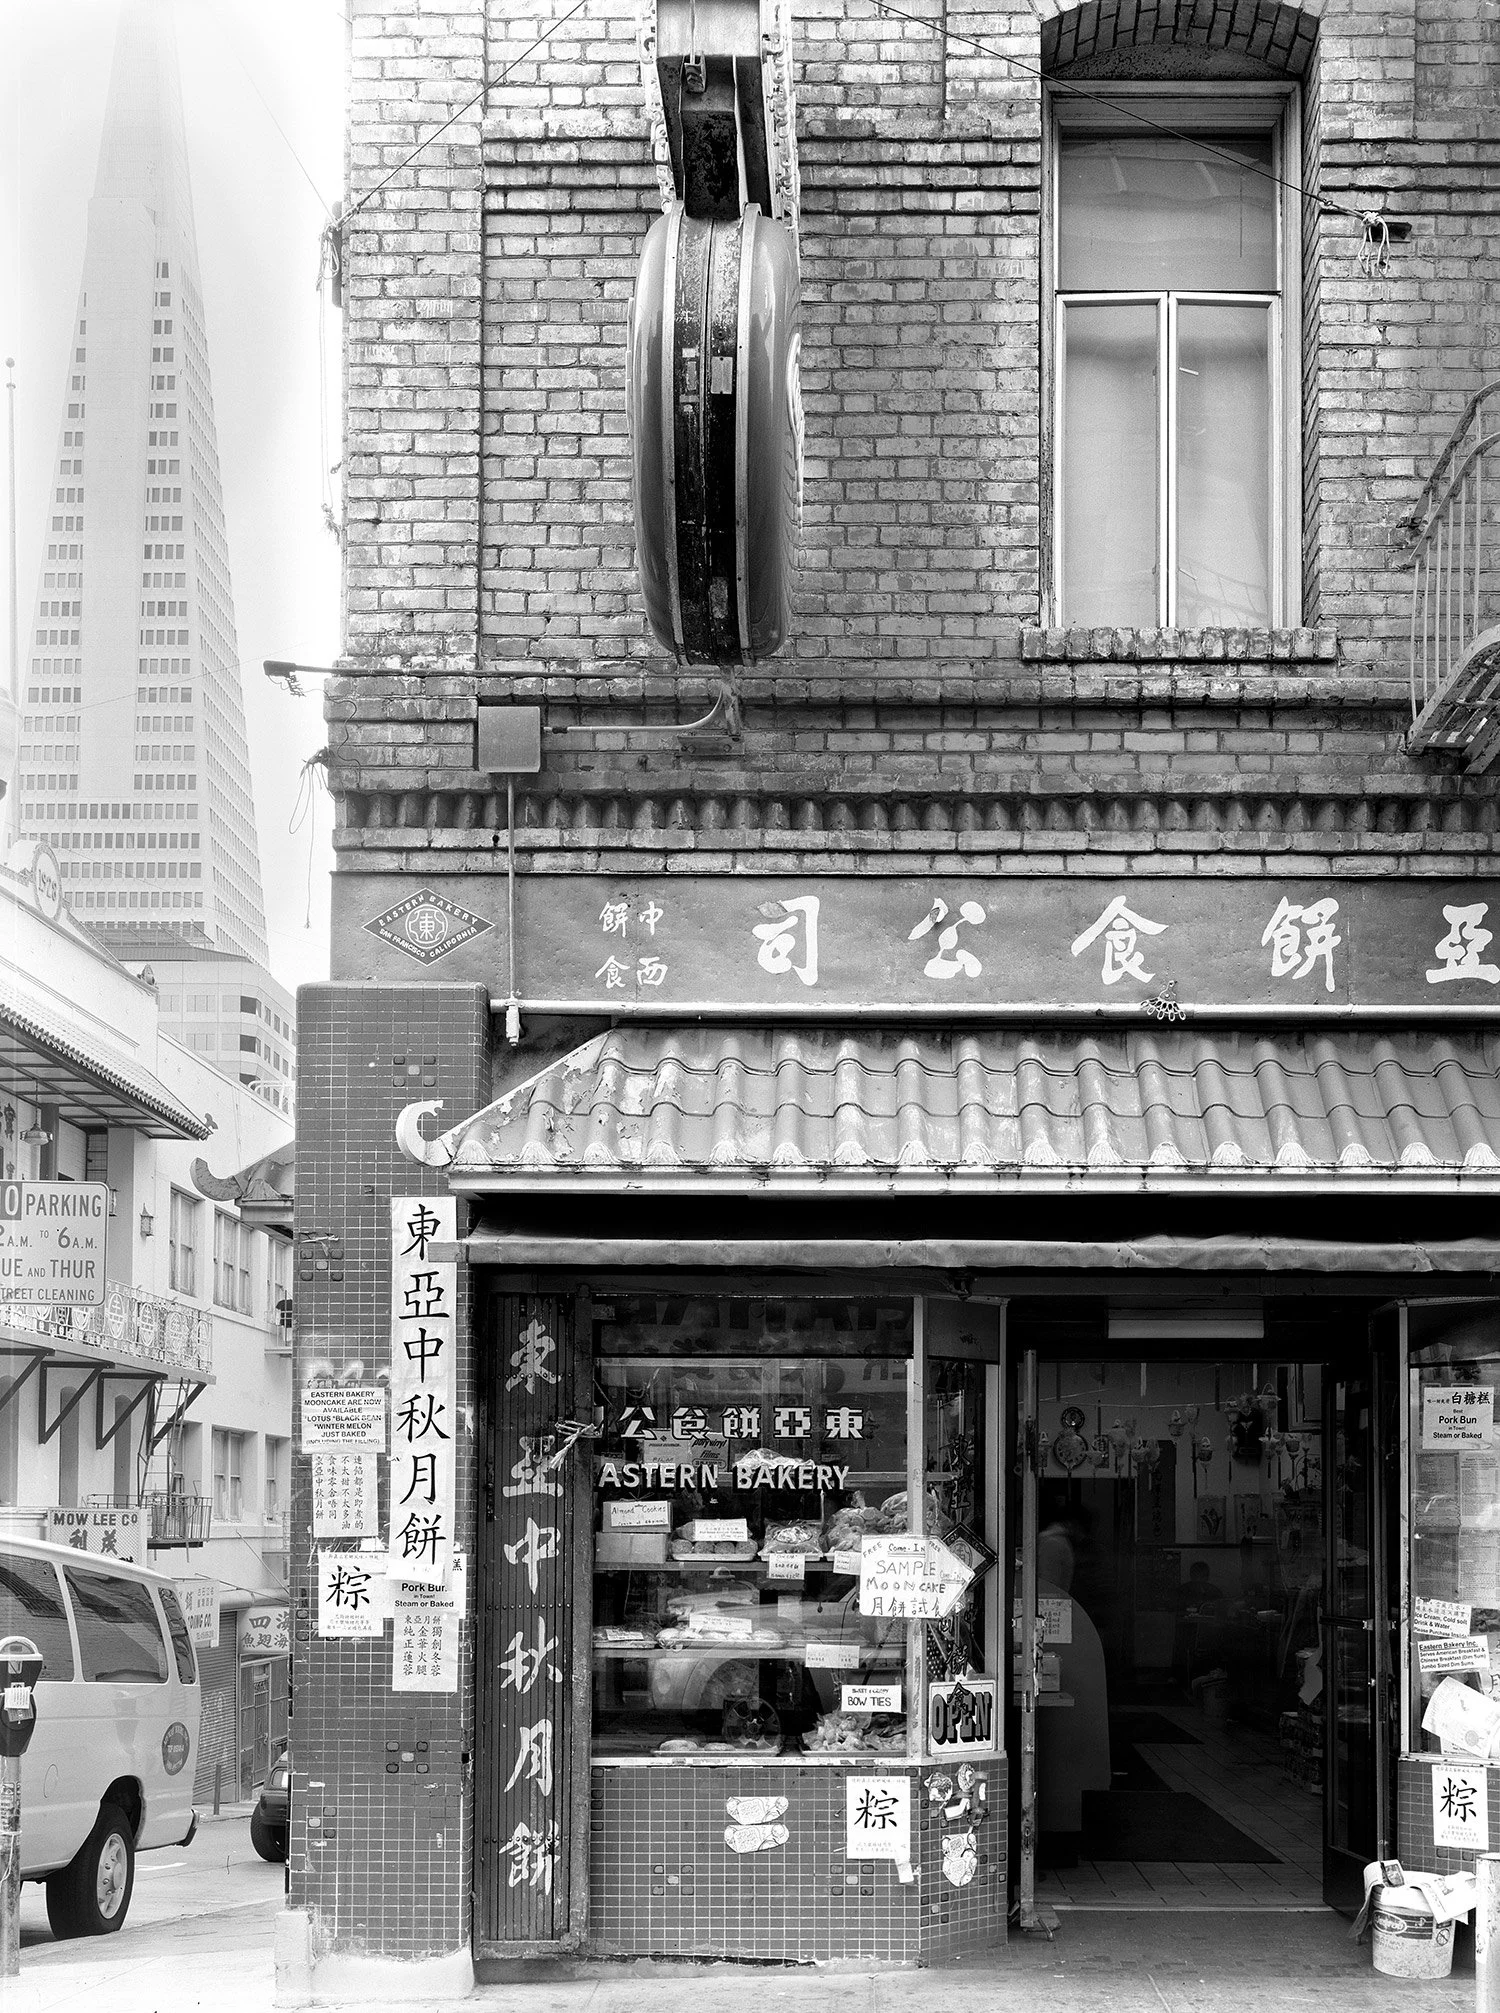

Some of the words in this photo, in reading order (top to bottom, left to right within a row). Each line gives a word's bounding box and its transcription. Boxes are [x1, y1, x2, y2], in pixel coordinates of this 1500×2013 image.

[378, 894, 424, 927] EASTERN
[430, 895, 478, 925] BAKERY
[379, 928, 392, 939] SAN
[392, 935, 426, 957] FRANCISCO
[429, 926, 477, 958] CALIFORNIA
[0, 1185, 19, 1215] O
[26, 1193, 102, 1217] PARKING
[40, 1230, 49, 1238] TO
[1, 1258, 23, 1277] UE
[27, 1268, 45, 1277] AND
[50, 1260, 95, 1278] THUR
[0, 1287, 33, 1300] TREET
[37, 1289, 95, 1301] CLEANING
[396, 1203, 450, 1565] 東亞中秋月餅
[1452, 1391, 1490, 1405] 白糖糕
[1439, 1416, 1459, 1424] Pork
[1460, 1416, 1477, 1424] Bun
[735, 1463, 849, 1490] BAKERY
[53, 1513, 89, 1526] MOW
[93, 1513, 116, 1526] LEE
[863, 1541, 883, 1558] FREE
[876, 1560, 936, 1576] SAMPLE
[325, 1565, 372, 1611] 粽
[401, 1583, 425, 1592] Pork
[866, 1577, 916, 1592] MOON
[919, 1582, 946, 1594] CAKE
[394, 1600, 419, 1608] Steam
[430, 1600, 454, 1608] Baked
[848, 1696, 867, 1706] BOW
[870, 1696, 892, 1707] TIES
[931, 1691, 993, 1745] OPEN
[1440, 1777, 1478, 1823] 粽
[853, 1788, 899, 1830] 粽
